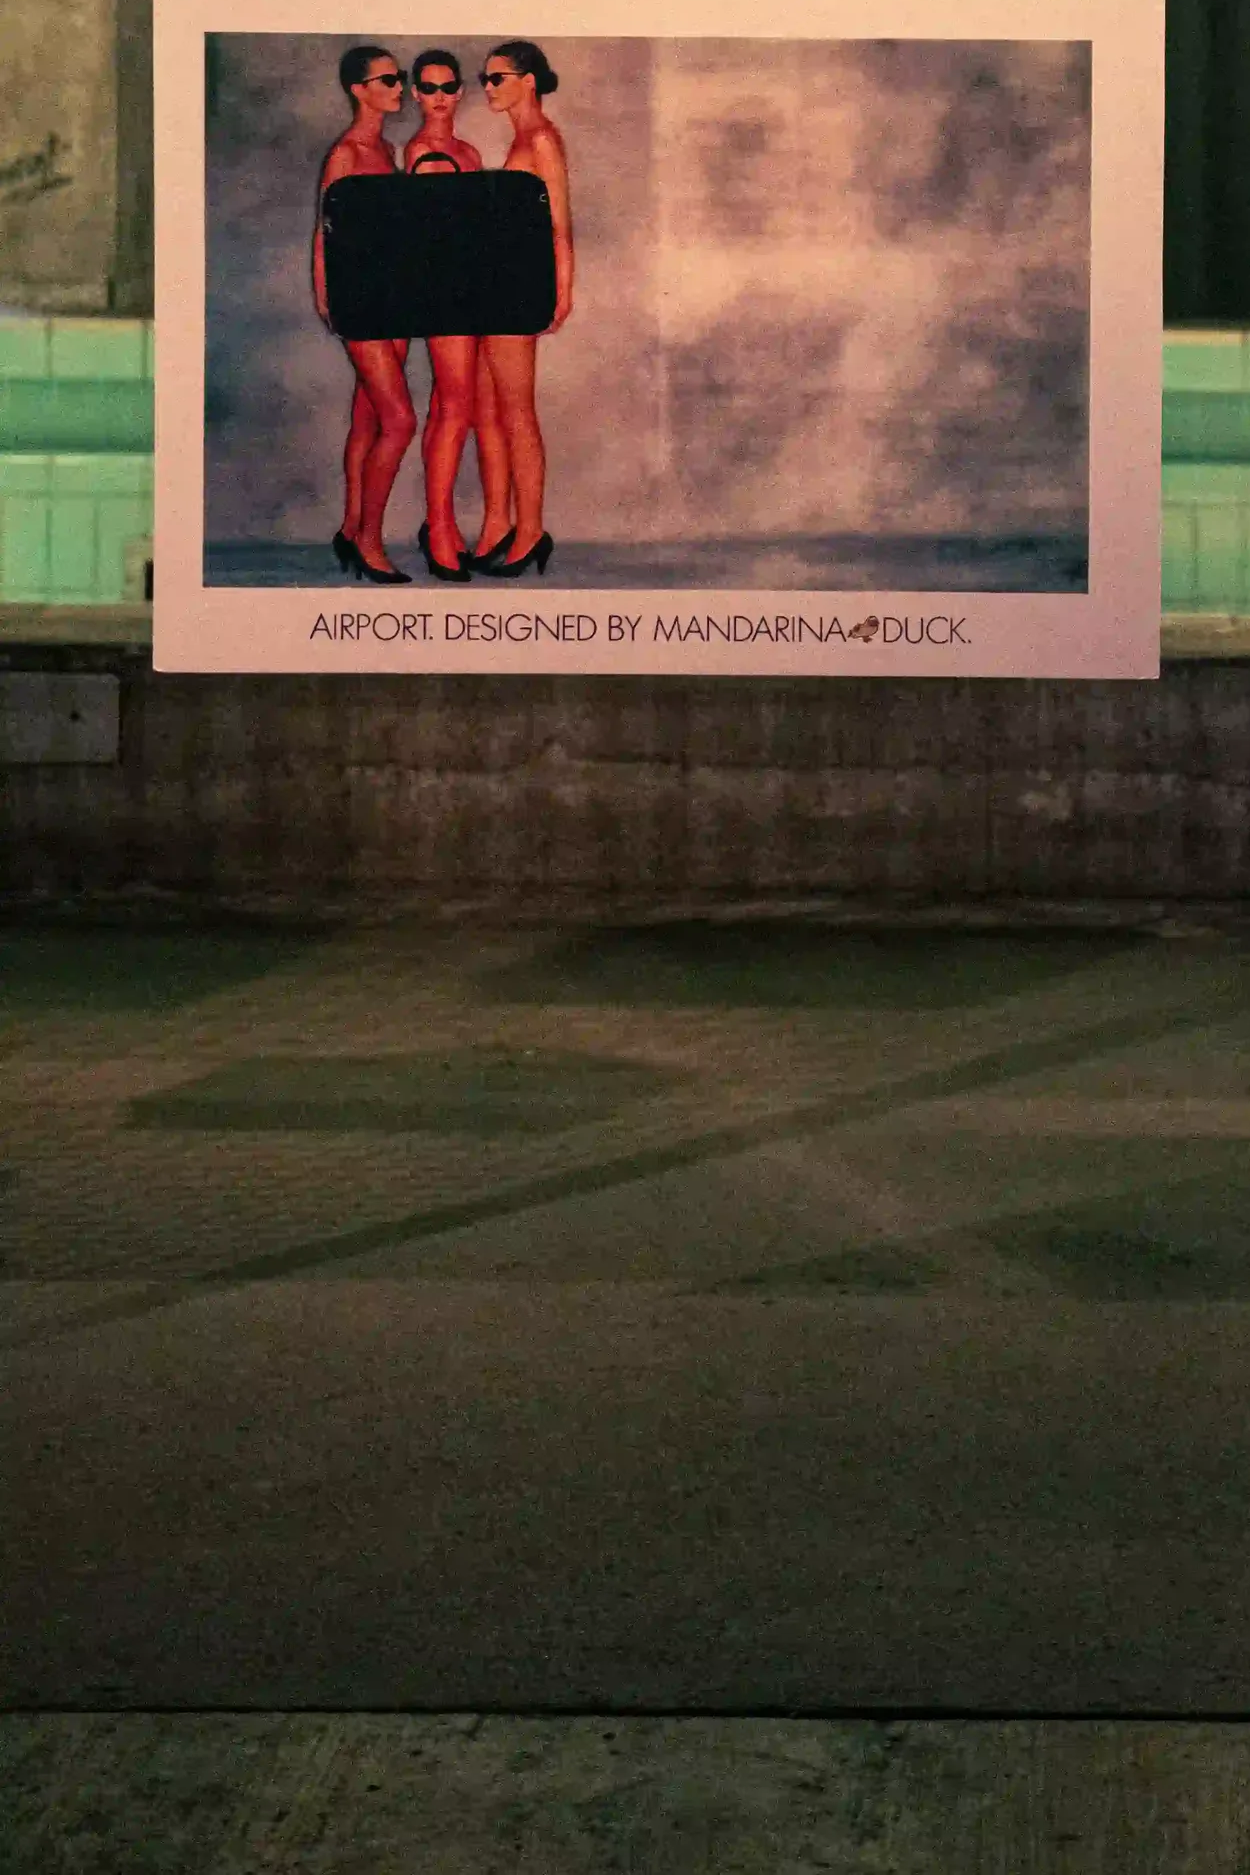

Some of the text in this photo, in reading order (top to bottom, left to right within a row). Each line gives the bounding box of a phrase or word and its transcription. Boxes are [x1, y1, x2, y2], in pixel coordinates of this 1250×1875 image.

[308, 612, 973, 645] AIRPORT. DESIGNED BY MANDARINA DUCK.
